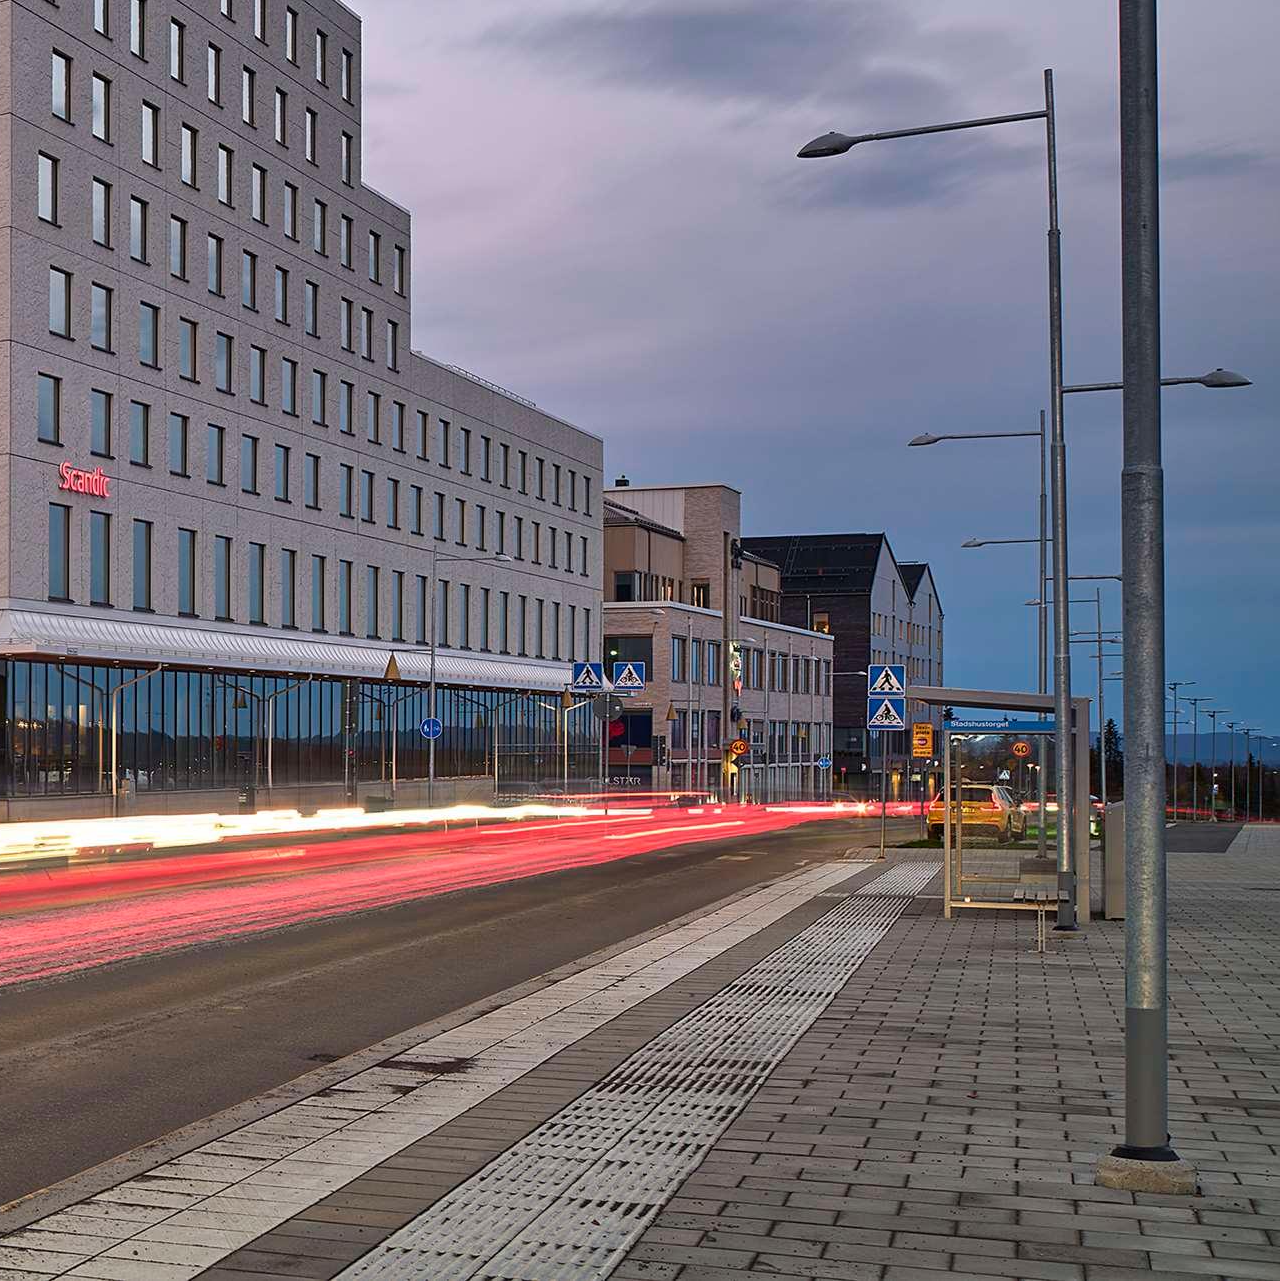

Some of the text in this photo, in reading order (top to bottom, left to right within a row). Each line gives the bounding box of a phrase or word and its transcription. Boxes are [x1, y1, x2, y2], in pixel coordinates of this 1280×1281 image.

[59, 462, 110, 497] Scandic
[950, 720, 1009, 729] Stadshustorget
[733, 742, 746, 751] 40
[1014, 745, 1027, 754] 40
